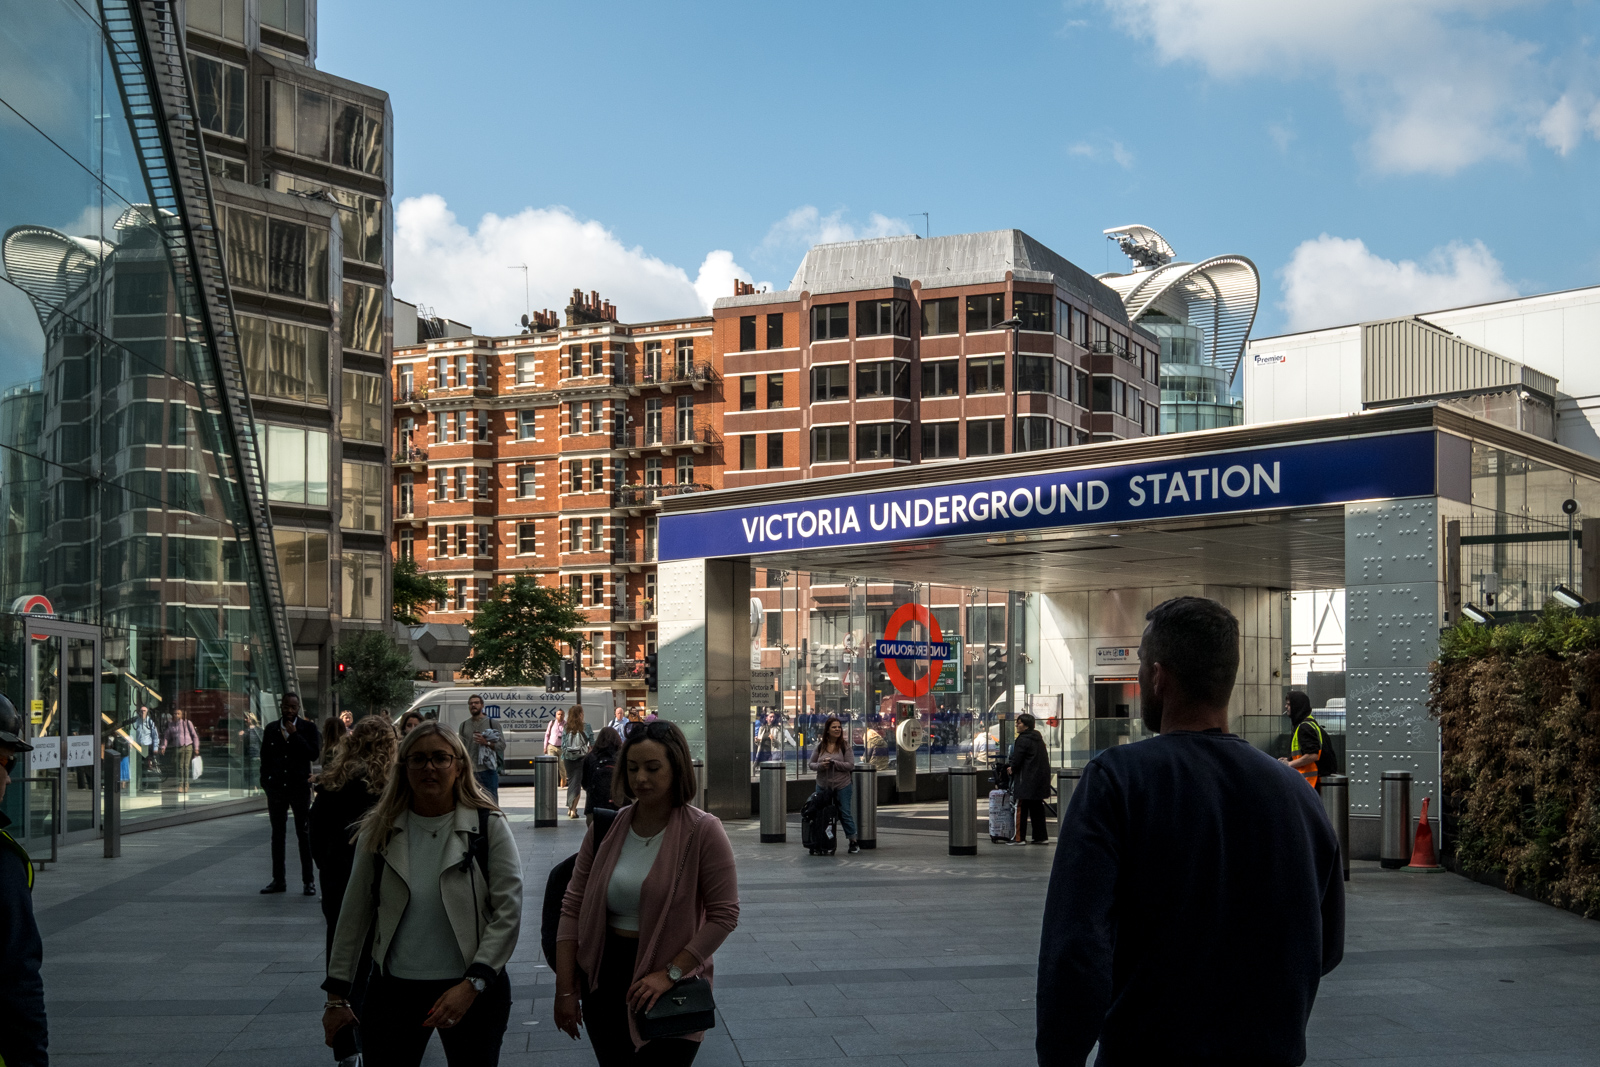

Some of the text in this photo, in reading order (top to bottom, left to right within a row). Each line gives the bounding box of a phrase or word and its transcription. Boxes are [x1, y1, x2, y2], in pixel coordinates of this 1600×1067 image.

[1257, 354, 1283, 364] Premier
[742, 461, 1281, 543] VICTORIA UNDERGROUND STATION
[539, 693, 566, 701] GYROS
